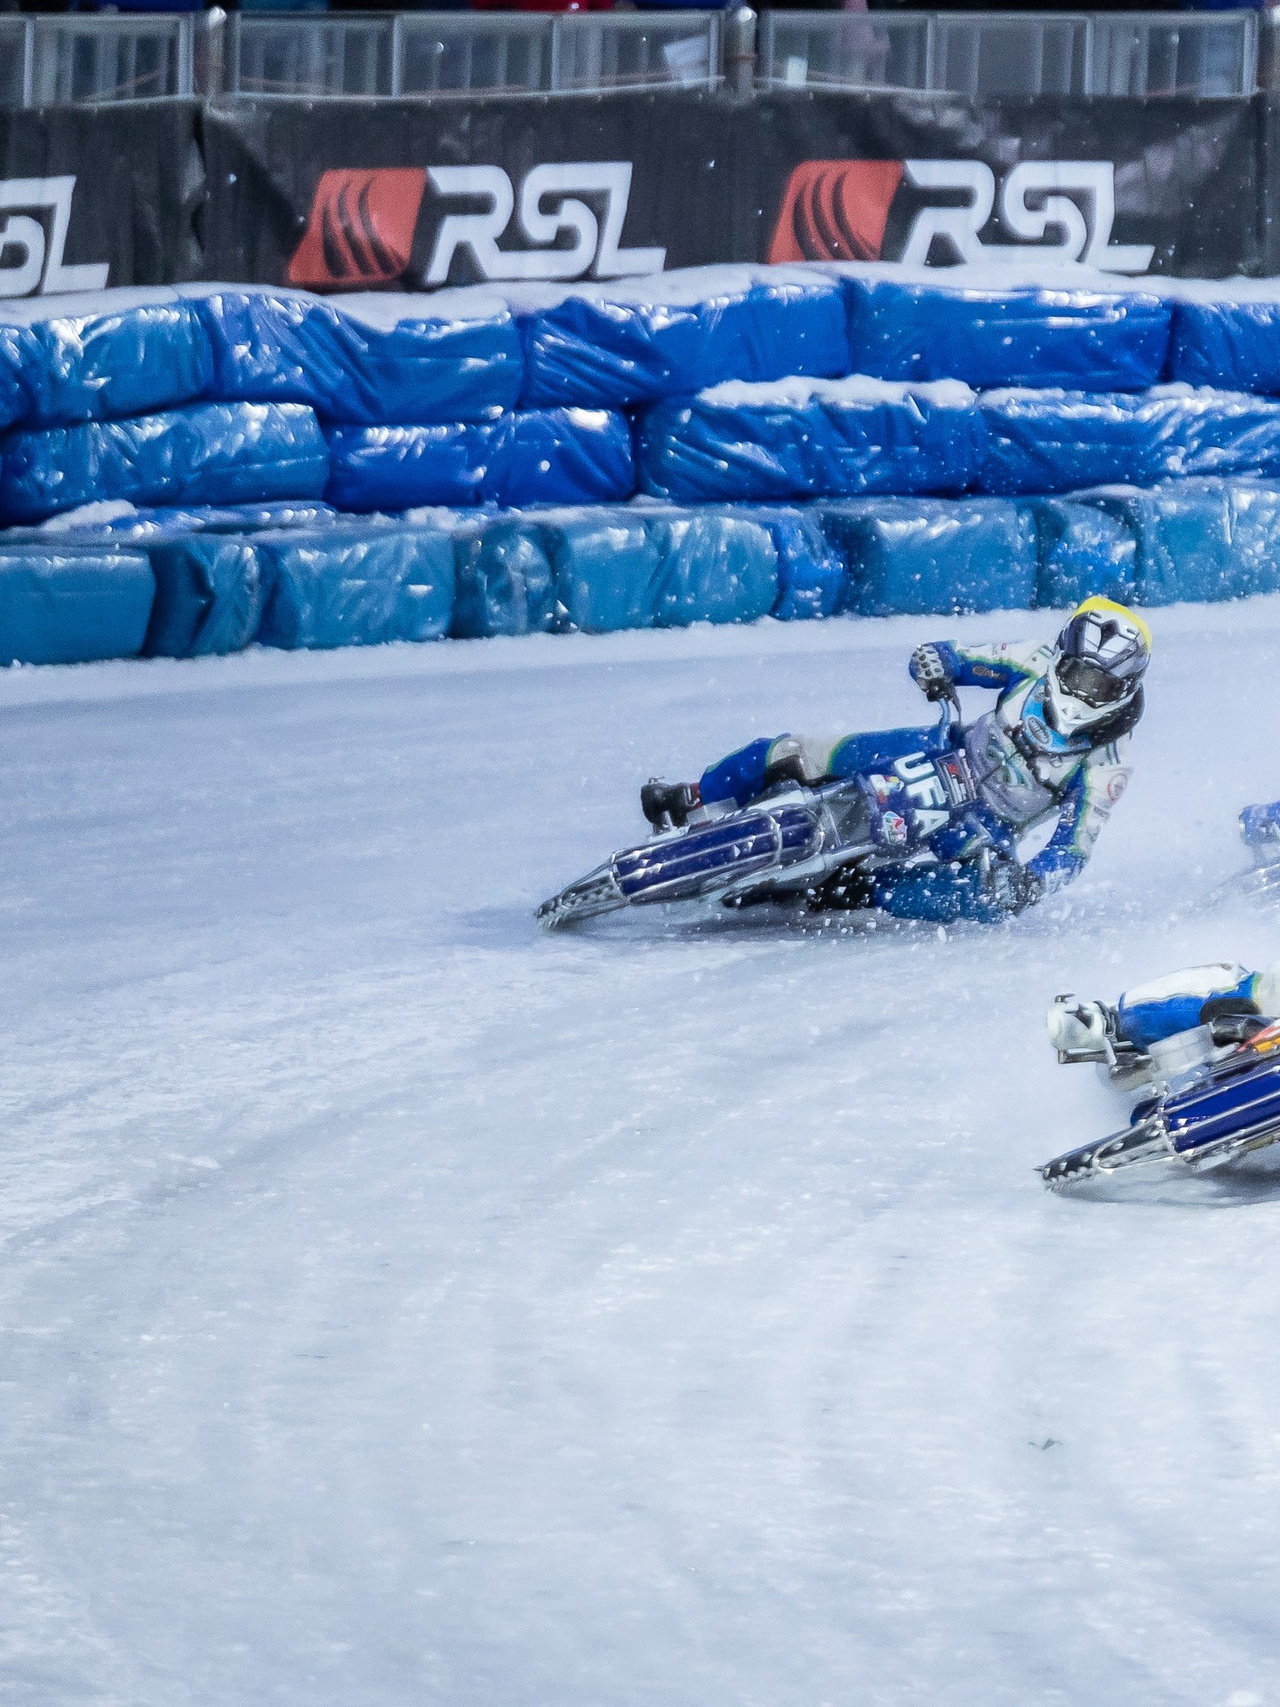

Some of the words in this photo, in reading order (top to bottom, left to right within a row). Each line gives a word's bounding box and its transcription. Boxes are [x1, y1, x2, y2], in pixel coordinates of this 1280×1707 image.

[427, 162, 667, 285] RSL
[904, 160, 1155, 274] RSL
[894, 751, 950, 838] UFA
